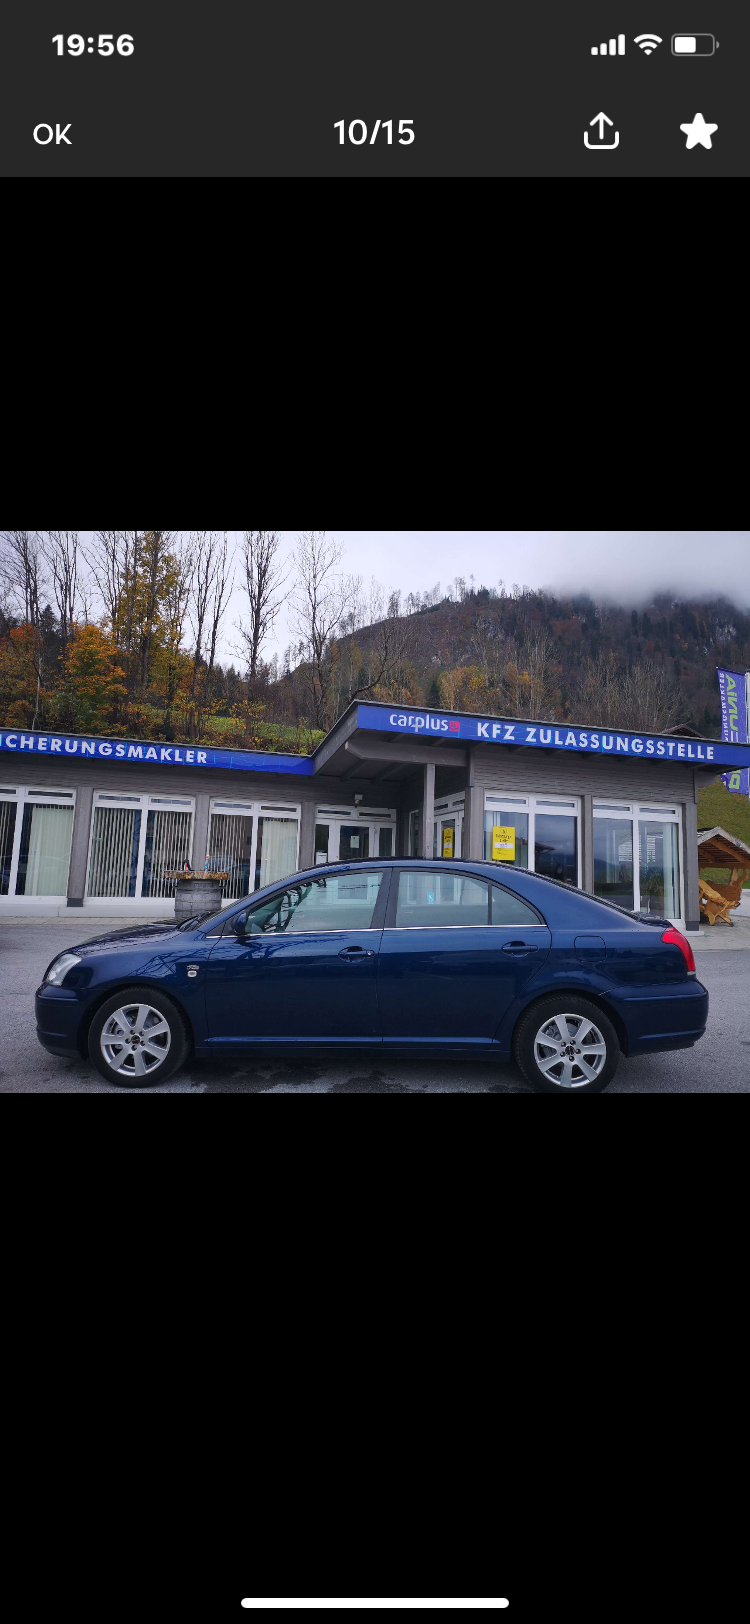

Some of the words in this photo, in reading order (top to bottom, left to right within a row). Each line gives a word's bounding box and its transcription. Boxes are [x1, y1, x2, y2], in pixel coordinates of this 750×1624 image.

[389, 713, 449, 733] carplus
[477, 722, 516, 741] KFZ
[525, 727, 715, 760] ZULASSUNGSSTELLE
